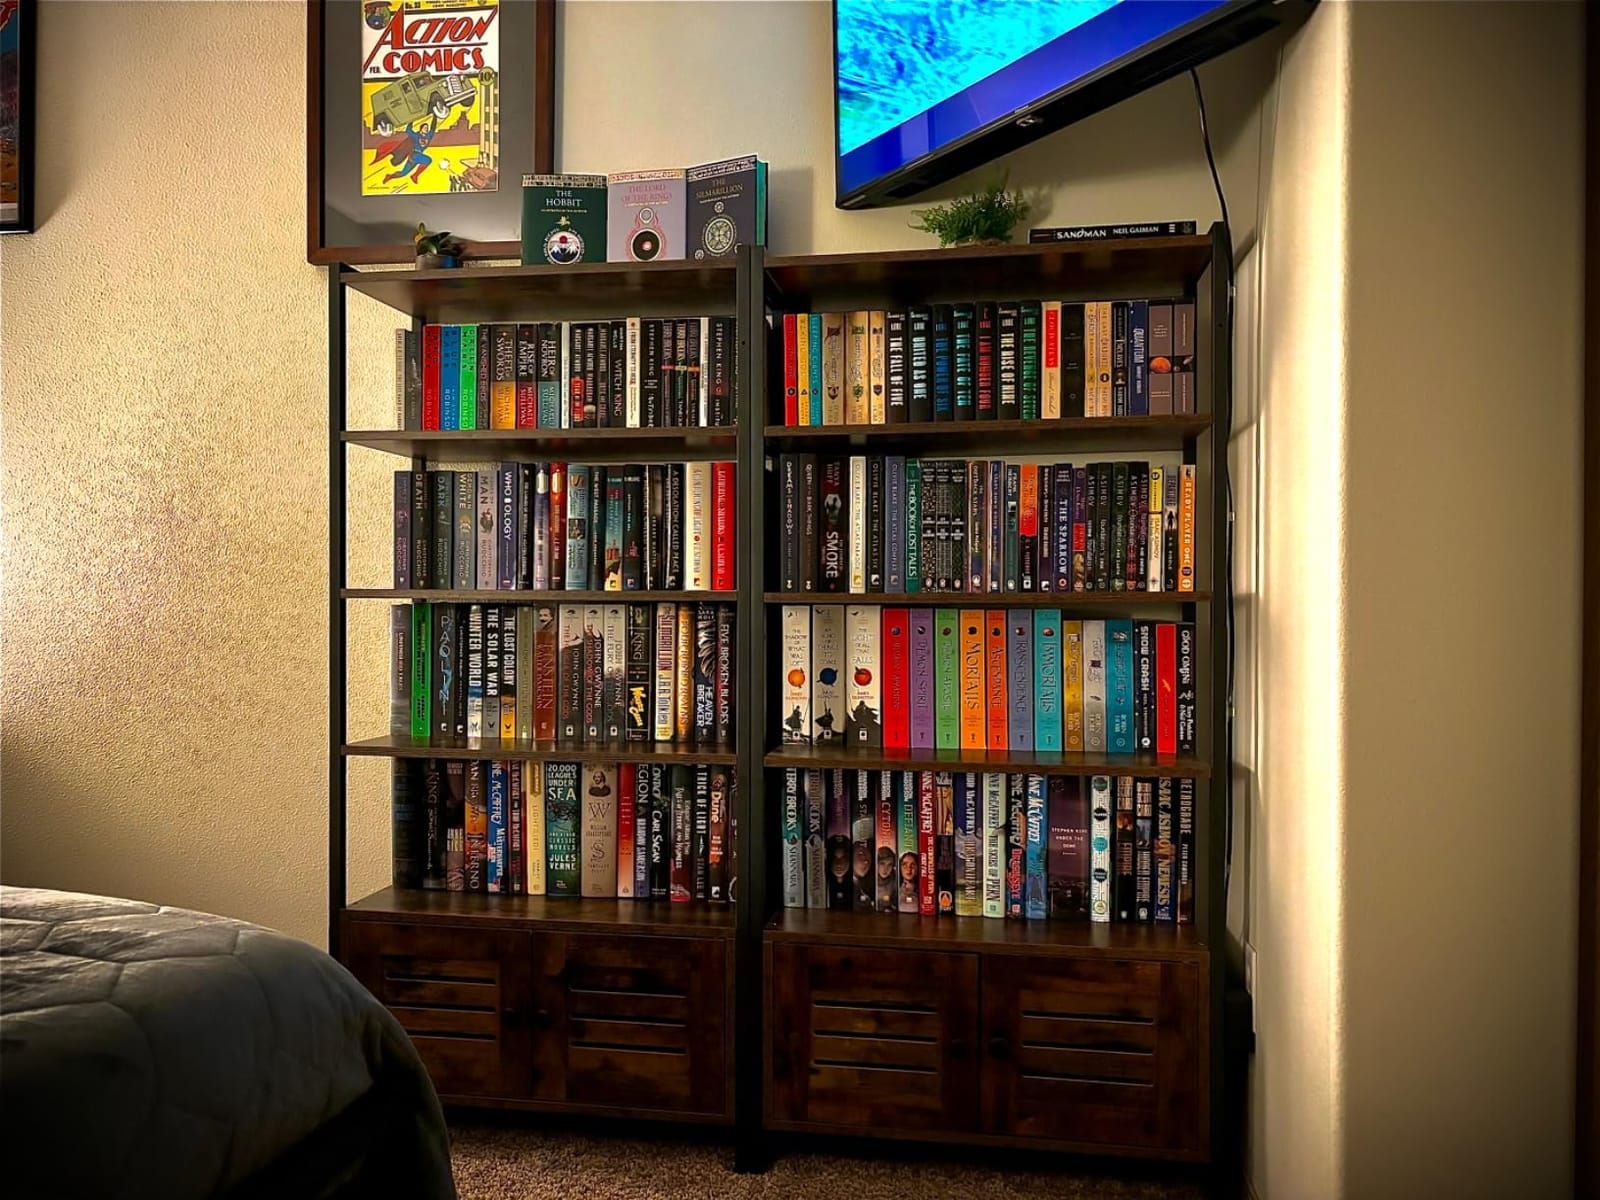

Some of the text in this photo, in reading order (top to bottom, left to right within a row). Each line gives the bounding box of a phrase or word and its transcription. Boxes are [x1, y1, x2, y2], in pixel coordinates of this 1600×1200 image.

[363, 4, 499, 74] ACTION
[382, 47, 486, 74] COMICS
[545, 198, 583, 207] HOBBIT
[890, 337, 904, 406] THE FALL OF FIVE
[912, 336, 926, 400] UNITED AS ONE
[956, 334, 970, 406] THE FATE OF TEN
[1000, 332, 1016, 405] THE RISE OF NINE
[480, 476, 488, 504] MAN
[504, 471, 512, 540] WHO OLOGY
[826, 531, 840, 579] SMOKE
[1059, 498, 1068, 574] THE SPARROW
[468, 612, 482, 687] WINTER WORLD
[487, 608, 498, 696] THE SOLAR WAR
[504, 616, 516, 686] THE LOST COLONY
[543, 644, 554, 710] EINSTEIN
[720, 624, 730, 724] FIVE BROKEN BLADES
[1140, 626, 1150, 691] SNOW CRASH
[696, 684, 705, 728] BREAKER
[705, 686, 713, 726] HEAVEN
[638, 764, 649, 804] EGION
[711, 792, 722, 823] Dune
[920, 770, 932, 834] ANNE McCAFFREY
[988, 790, 1000, 830] McCAFFREY
[1158, 776, 1172, 810] ISAAC
[1180, 778, 1192, 835] RETROGRADE
[652, 810, 665, 863] CARL SAGAN
[786, 796, 798, 832] BROOKS
[988, 836, 1000, 847] THE
[986, 878, 1000, 902] PERN
[1158, 858, 1172, 906] NEMESIS
